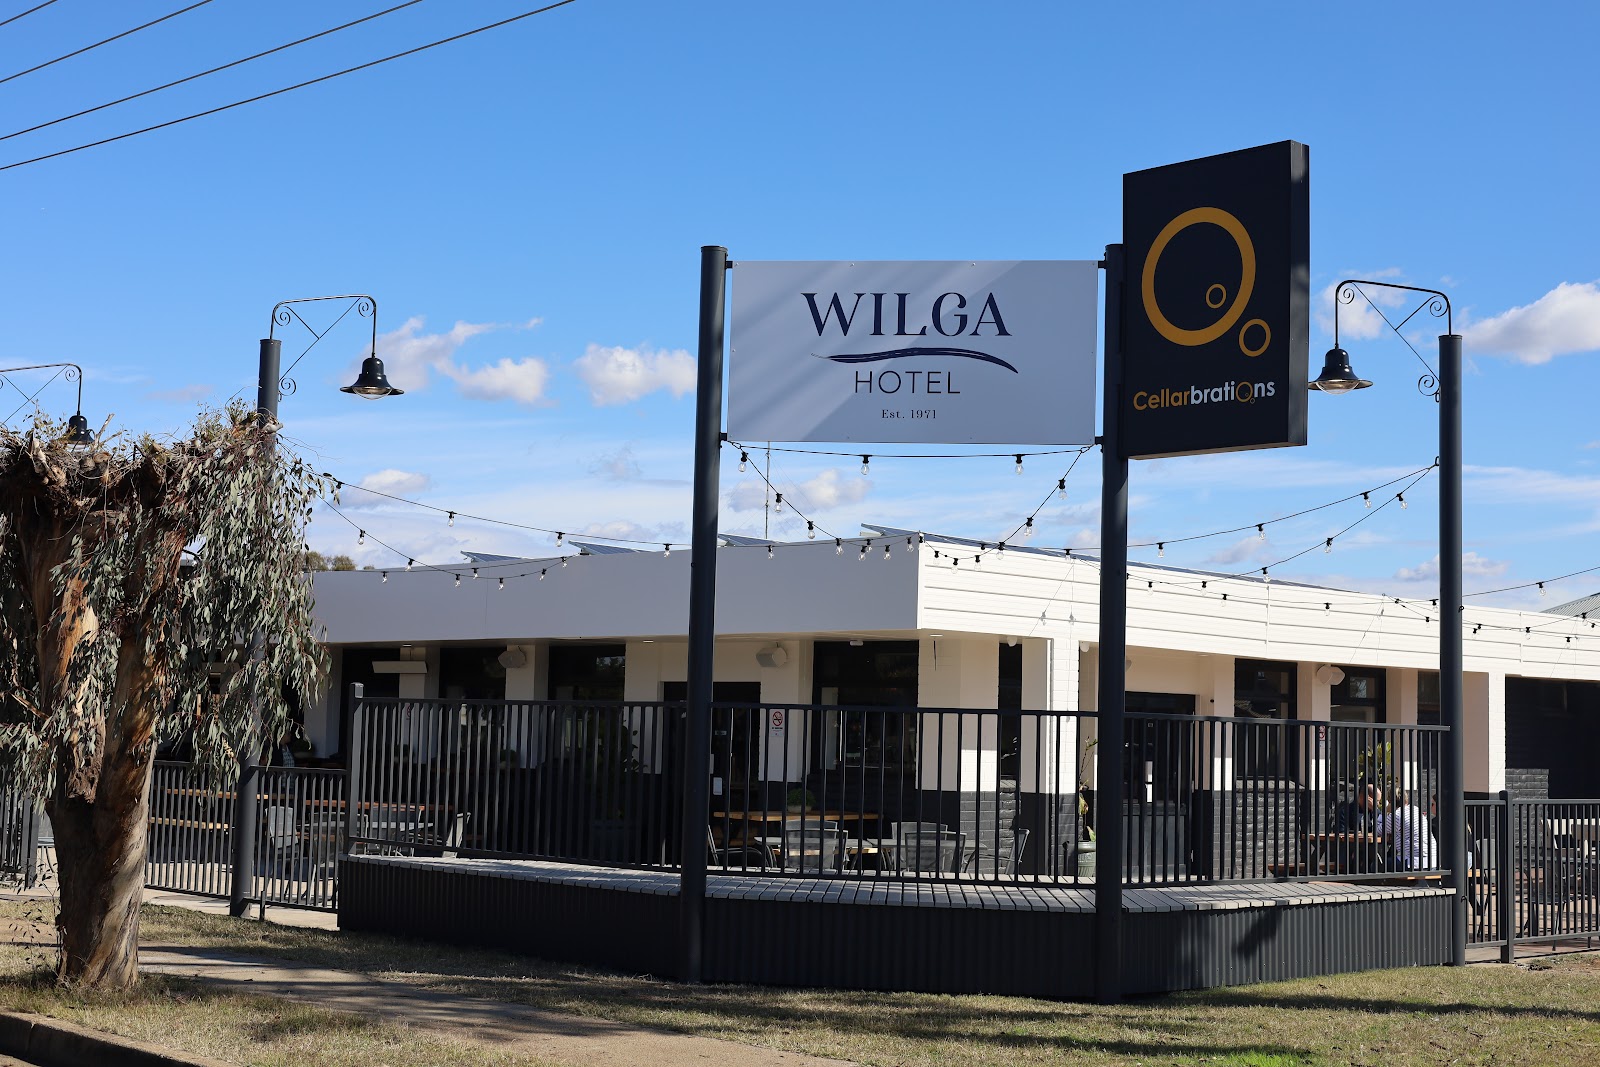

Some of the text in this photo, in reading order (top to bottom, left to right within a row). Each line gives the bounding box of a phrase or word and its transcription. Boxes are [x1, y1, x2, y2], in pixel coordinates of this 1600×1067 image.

[801, 292, 1013, 336] WILGA
[854, 370, 961, 394] HOTEL
[881, 409, 937, 419] Est. 1971
